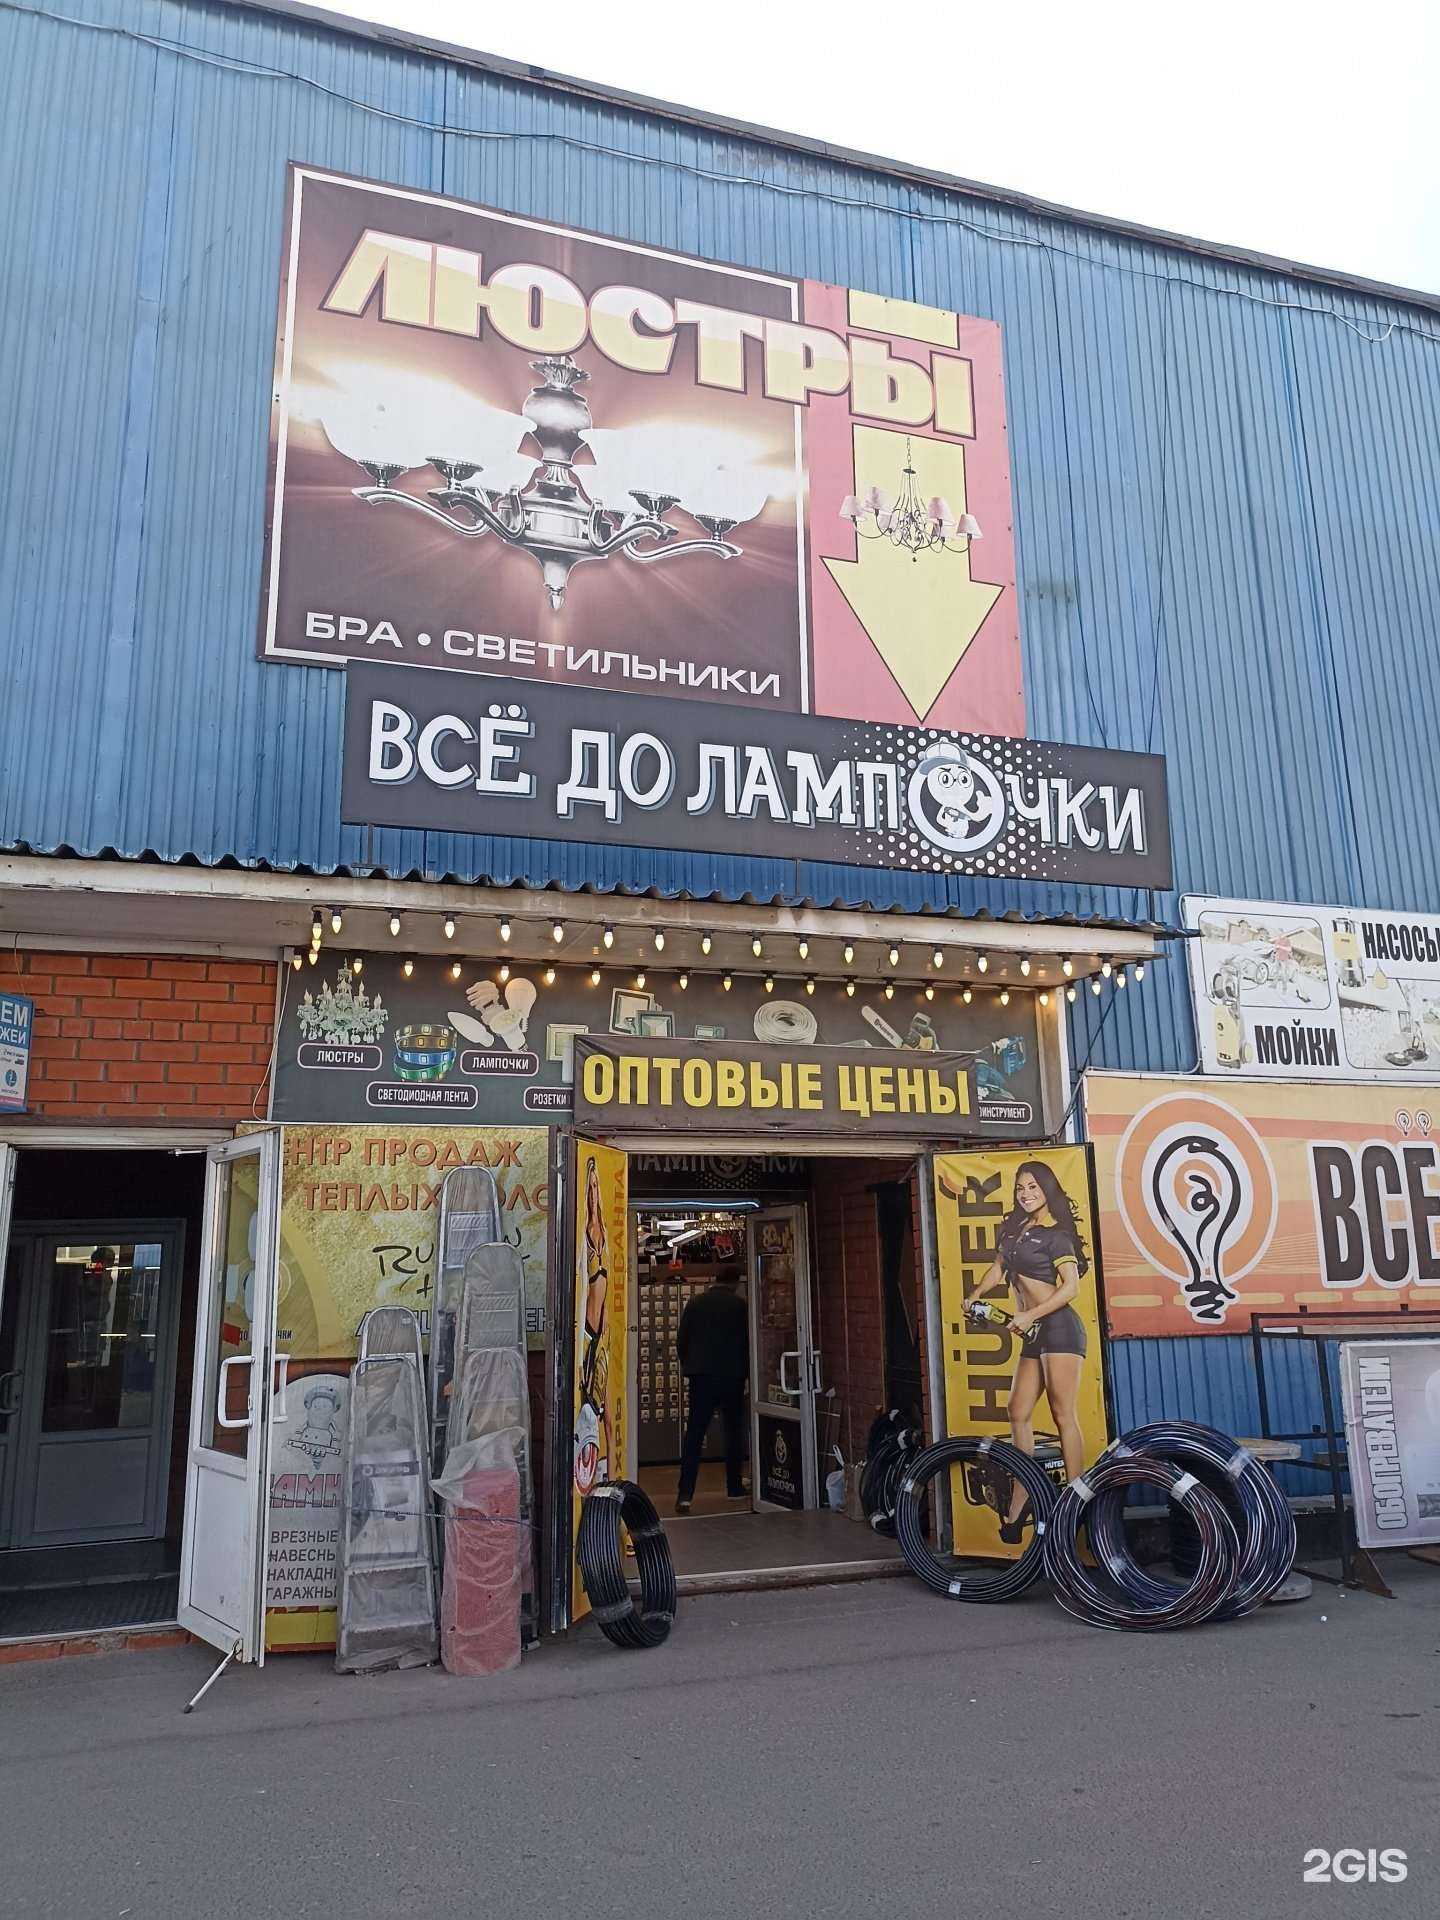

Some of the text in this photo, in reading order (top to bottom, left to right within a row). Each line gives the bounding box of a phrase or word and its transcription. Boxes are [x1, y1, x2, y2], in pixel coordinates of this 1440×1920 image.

[319, 229, 977, 440] ЛЮСТРЫ
[304, 612, 781, 698] БРА СВЕТИЛЬНИКИ
[367, 699, 1147, 855] ВСЁ ДО ЛАМПОЧКИ
[1361, 921, 1440, 964] НАСОСЫ
[0, 1000, 29, 1028] ЕМ
[316, 1050, 364, 1065] ЛЮСТРЫ
[1254, 1018, 1341, 1067] МОЙКИ
[472, 1056, 530, 1071] ЛАМПОЧКИ
[377, 1088, 469, 1104] СВЕТОДИОДНАЯ ЛЕНТА
[533, 1093, 567, 1105] РОЗЕТКИ
[582, 1054, 971, 1118] ОПТОВЫЕ ЦЕНЫ
[283, 1136, 523, 1170] НТР ПРОДАЖ
[303, 1182, 443, 1212] ТЕПЛЫХ
[614, 1167, 625, 1312] РЕСАНТА
[615, 1397, 623, 1480] ХРЬ
[1358, 1356, 1408, 1531] ОБОГРЕВАТЕЛИ
[271, 1530, 338, 1544] ВРЕЗНЫЕ
[267, 1567, 337, 1581] НАКЛАДН
[266, 1586, 337, 1600] ГАРАЖНЫ
